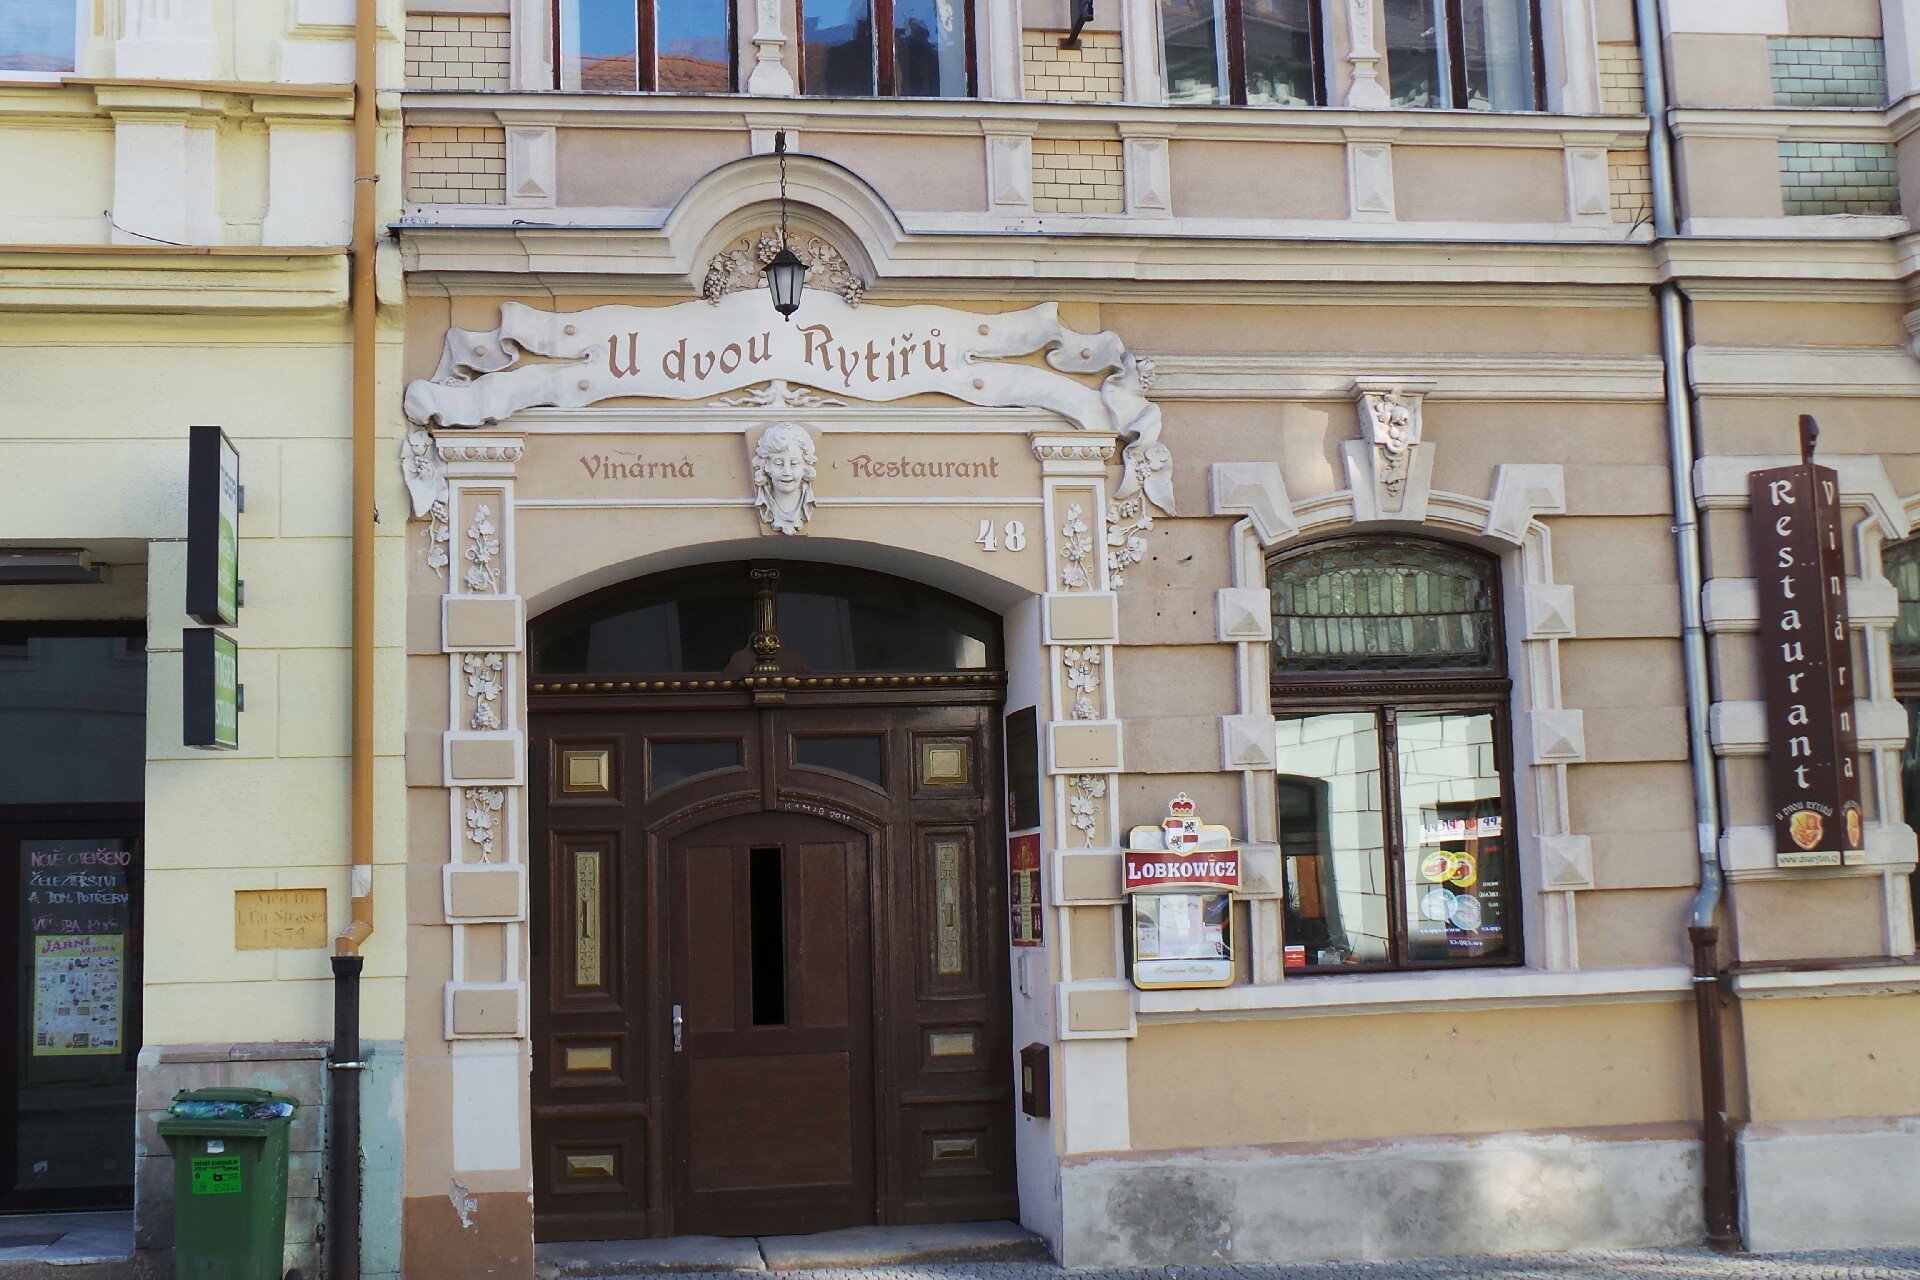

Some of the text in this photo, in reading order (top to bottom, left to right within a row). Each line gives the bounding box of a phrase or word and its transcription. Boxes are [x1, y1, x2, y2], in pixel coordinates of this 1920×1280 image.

[607, 323, 949, 388] U dvou Rytířů
[847, 454, 999, 478] Restaurant
[975, 519, 1026, 552] 48
[1768, 479, 1812, 789] Restaurant
[1821, 480, 1854, 778] Vinárna
[215, 650, 236, 692] TIGER
[1128, 861, 1236, 880] LOBKOWICZ
[28, 891, 41, 904] A
[42, 938, 91, 954] JARNÍ
